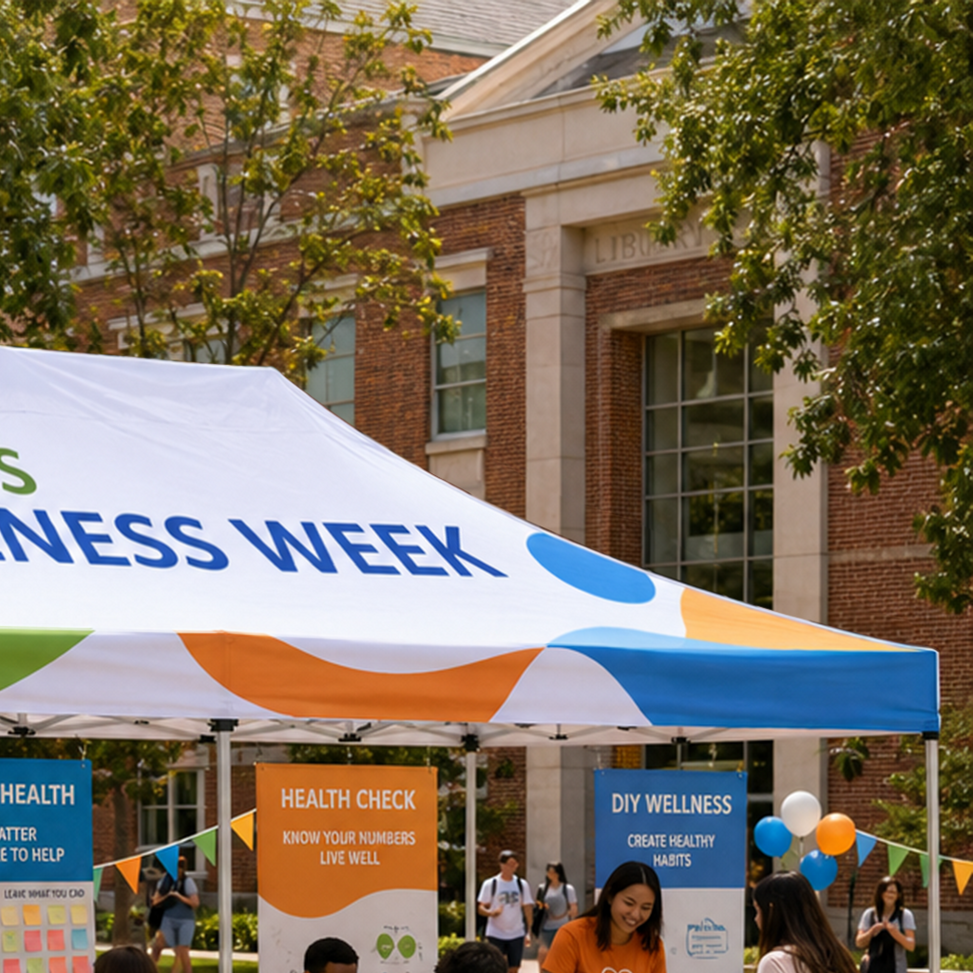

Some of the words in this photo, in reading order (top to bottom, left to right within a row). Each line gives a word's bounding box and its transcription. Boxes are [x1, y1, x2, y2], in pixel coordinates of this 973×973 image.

[227, 518, 509, 578] WEEK
[0, 783, 75, 806] HEALTH
[281, 787, 351, 809] HEALTH
[356, 788, 416, 810] CHECK
[611, 792, 641, 814] DIY
[644, 793, 733, 815] WELLNESS
[282, 830, 321, 845] KNOW
[322, 830, 357, 846] YOUR
[358, 830, 416, 846] NUMBERS
[627, 833, 667, 848] CREATE
[668, 834, 716, 849] HEALTHY
[9, 846, 29, 863] TO
[31, 847, 65, 863] HELP
[319, 849, 346, 866] LIVE
[348, 850, 381, 866] WELL
[653, 853, 692, 868] HABITS
